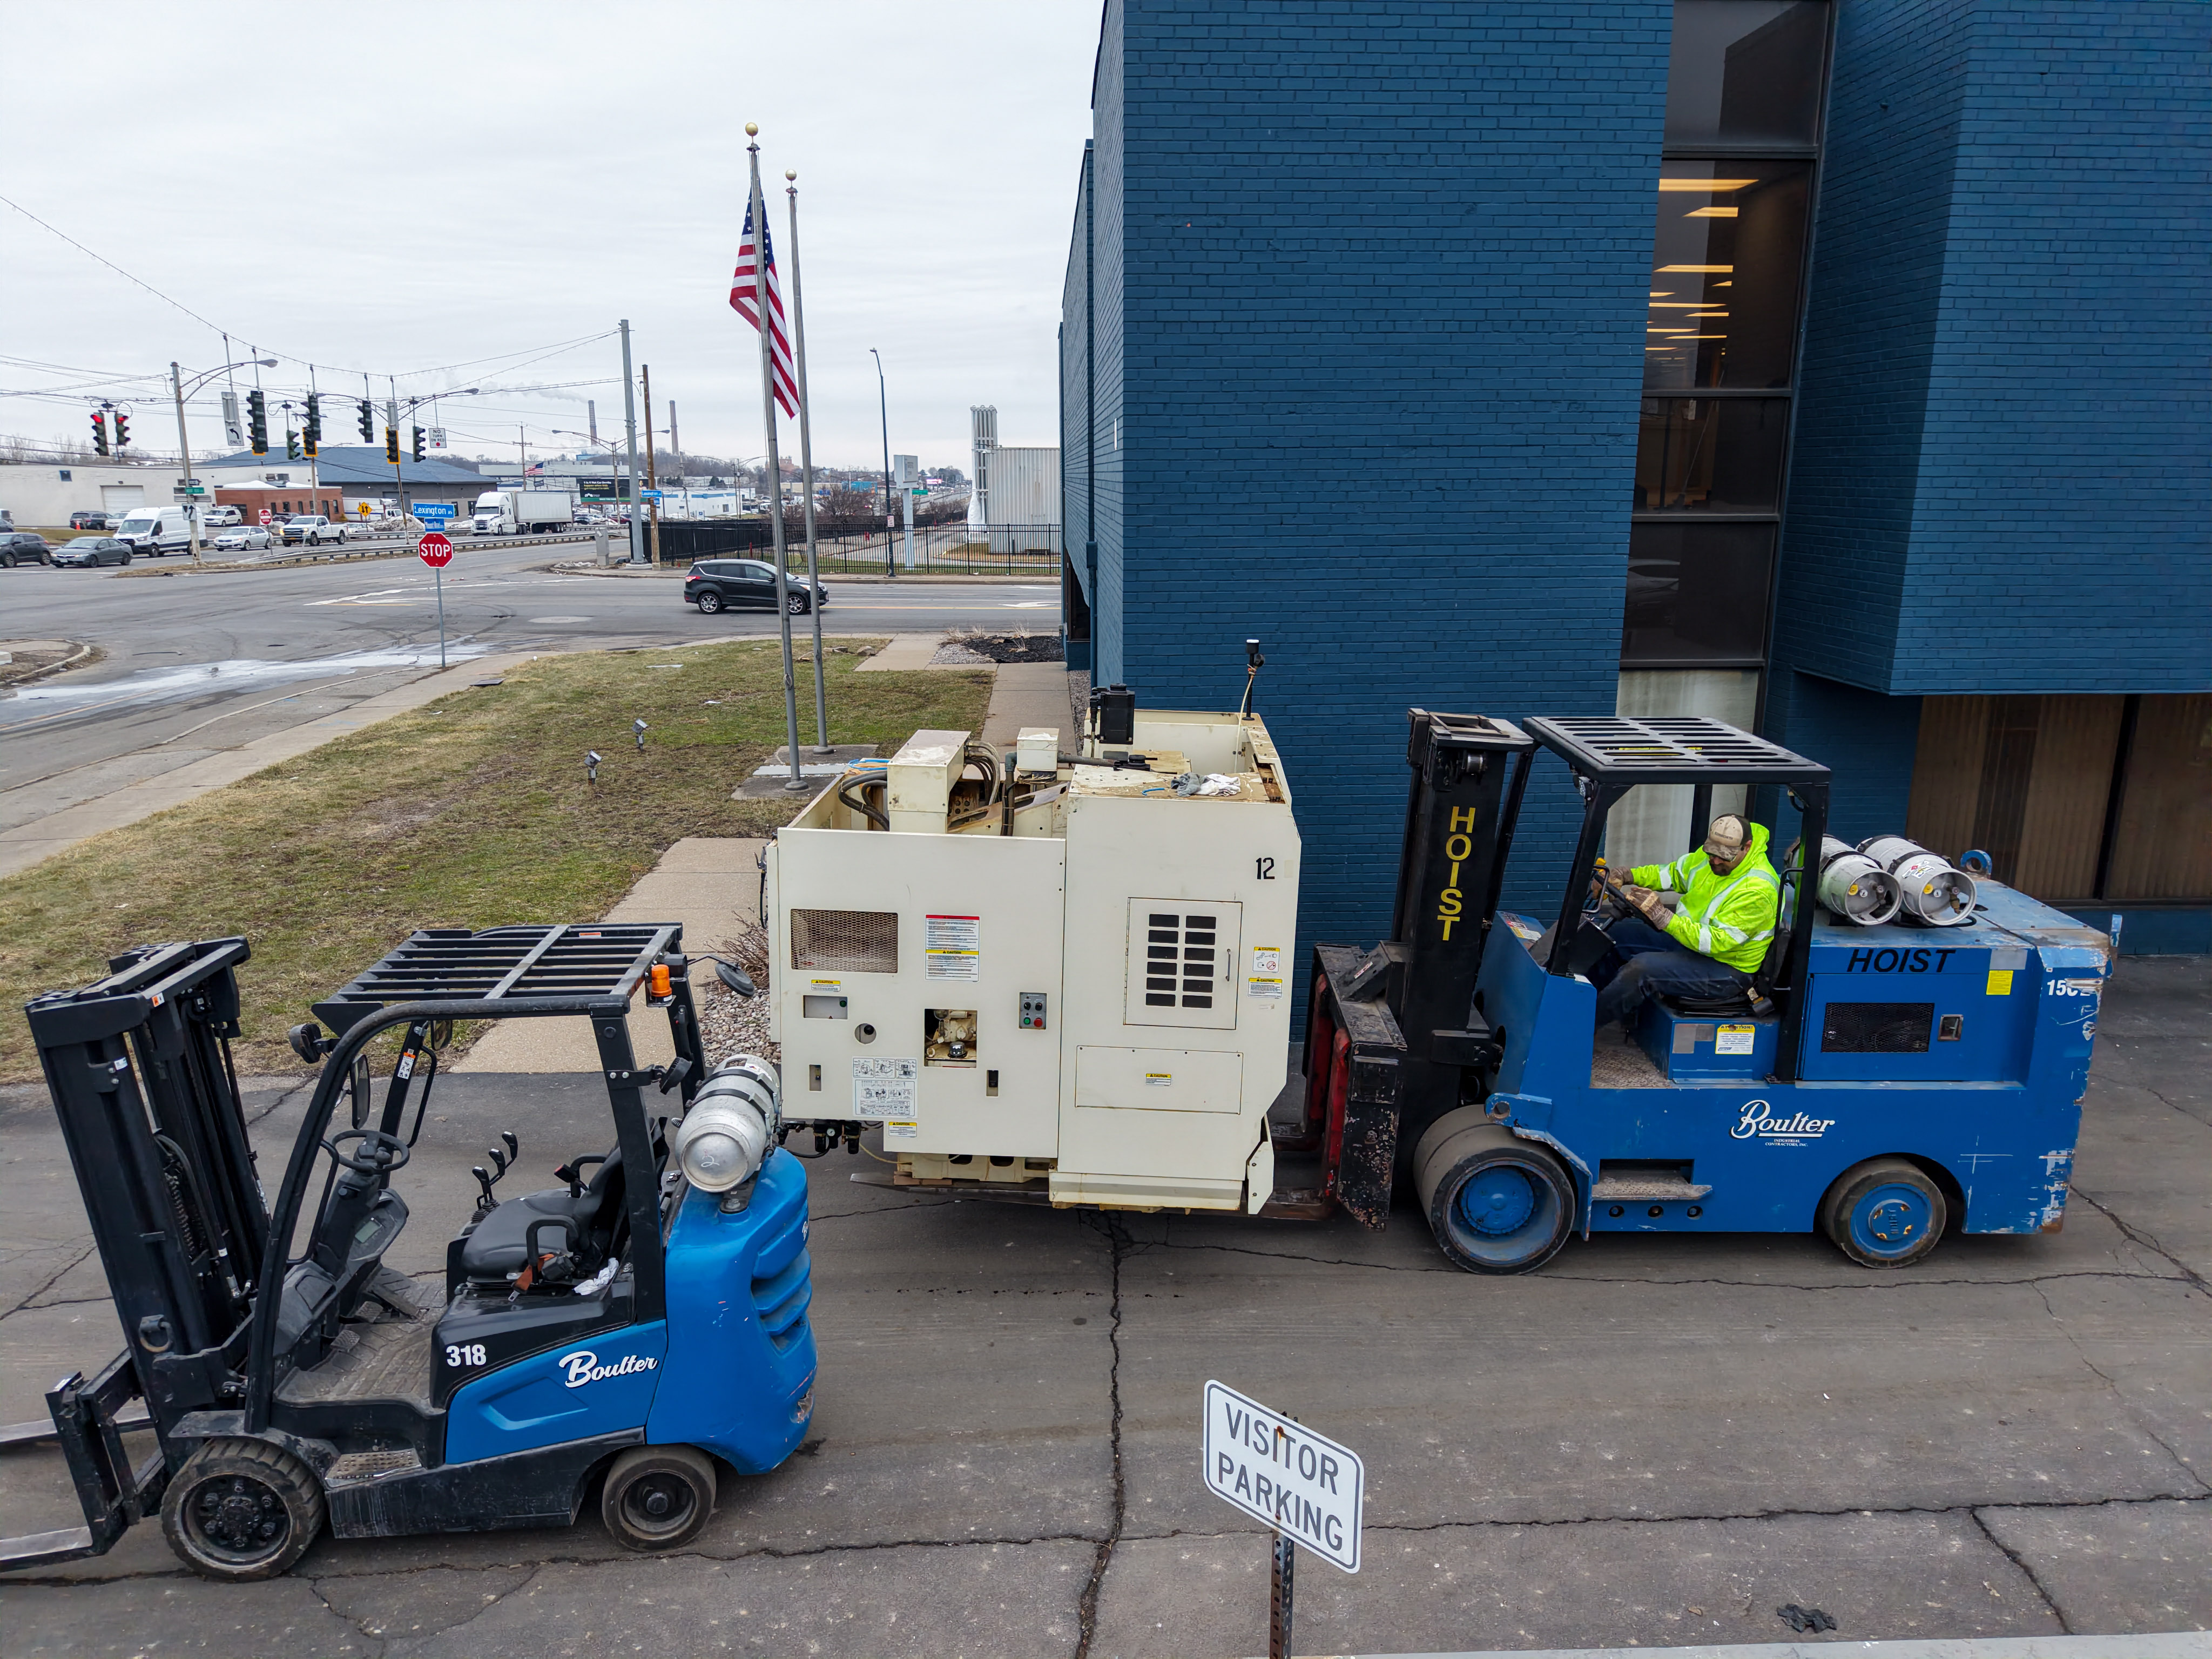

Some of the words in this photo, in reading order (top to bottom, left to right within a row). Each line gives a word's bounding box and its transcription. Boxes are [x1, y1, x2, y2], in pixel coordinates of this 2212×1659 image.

[414, 505, 446, 516] Lexington
[421, 544, 450, 557] STOP
[1256, 858, 1275, 880] 12
[1437, 806, 1476, 941] HOIST
[1847, 949, 1956, 973] HOIST
[1731, 1100, 1836, 1139] Boulter
[446, 1344, 487, 1367] 318
[558, 1351, 658, 1388] Boulter
[1225, 1402, 1339, 1496] VISITOR
[1219, 1451, 1343, 1552] PARKING
